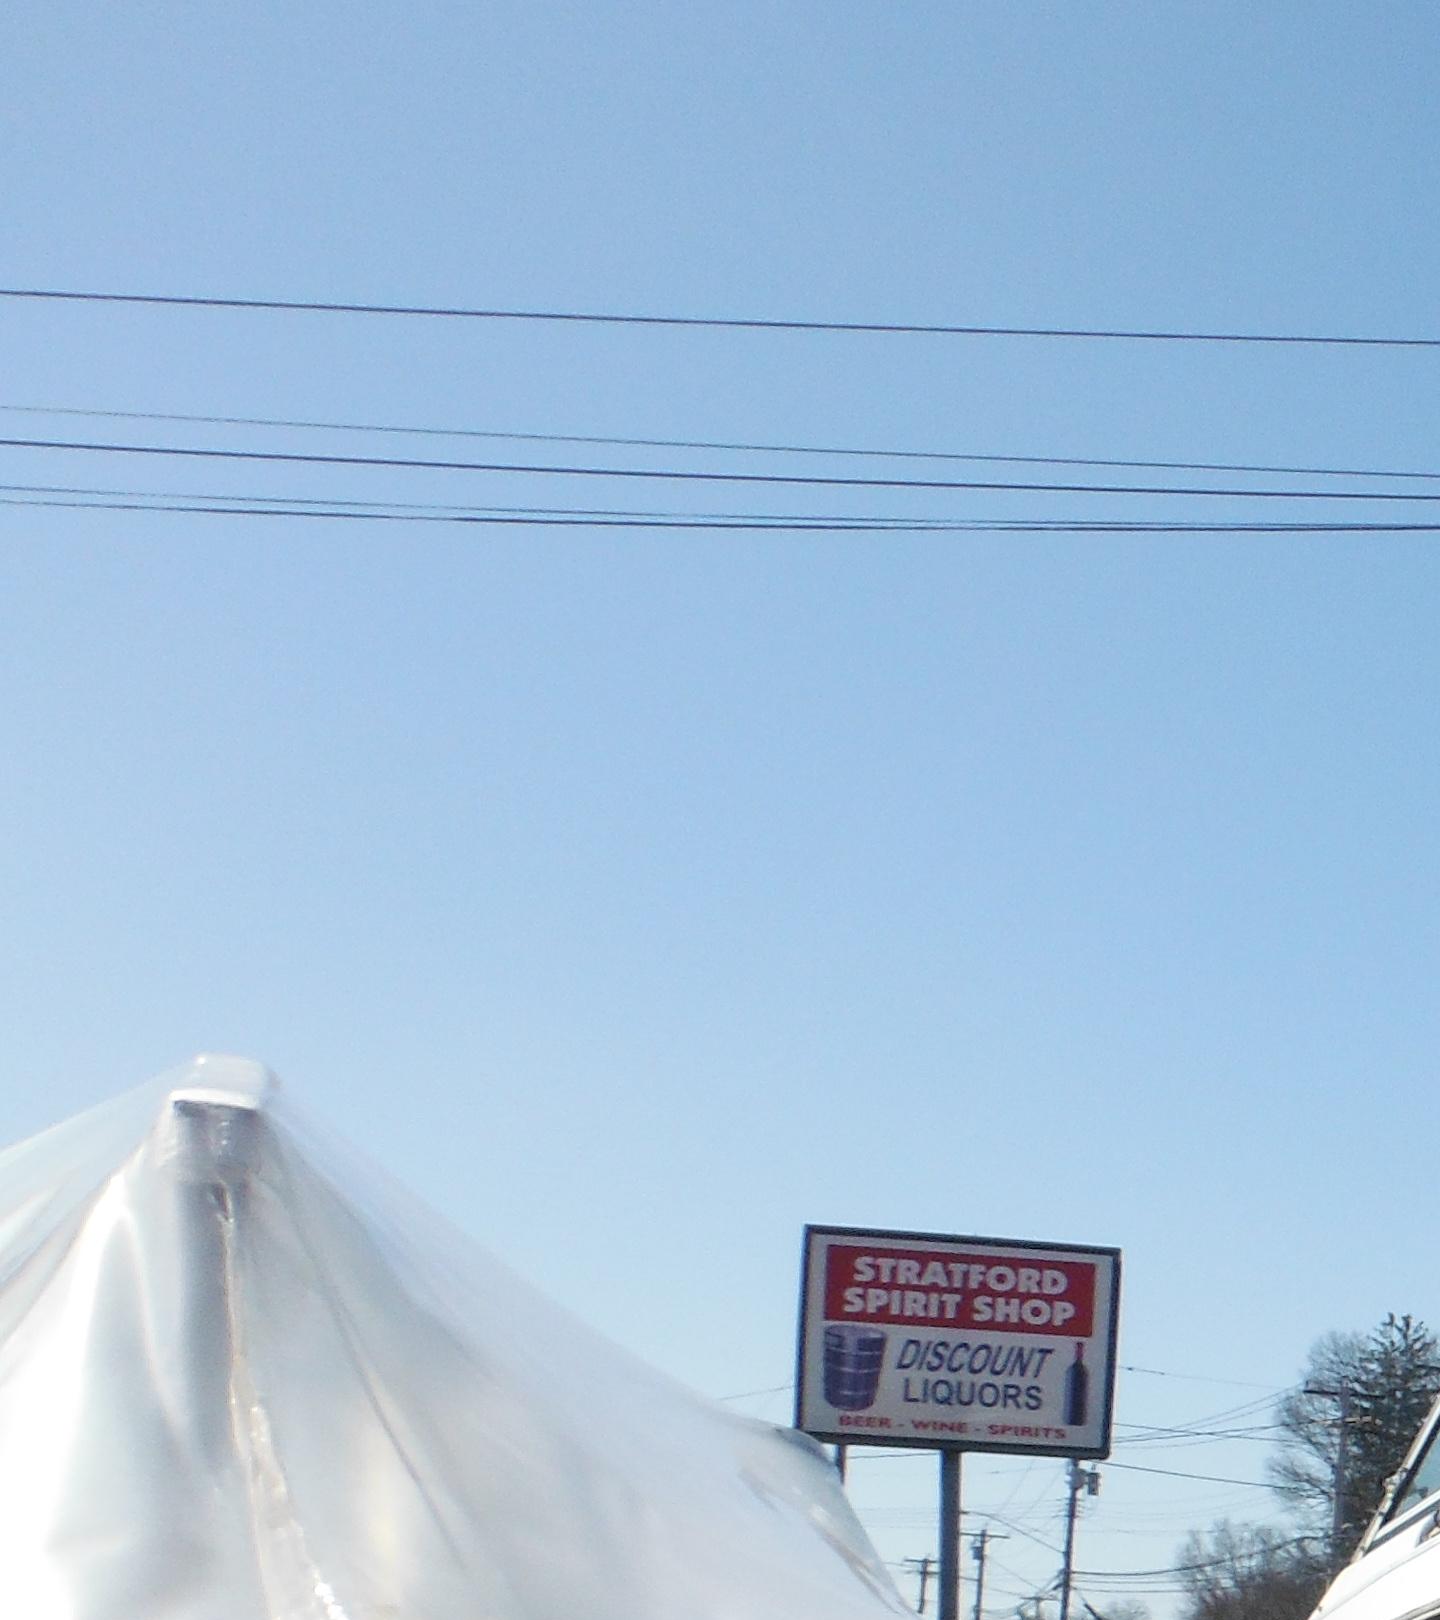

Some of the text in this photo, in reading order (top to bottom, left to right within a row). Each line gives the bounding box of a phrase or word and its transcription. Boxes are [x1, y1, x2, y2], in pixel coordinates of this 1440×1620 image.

[853, 1256, 1068, 1295] STRATFORD
[842, 1287, 1076, 1327] SPIRIT SHOP
[896, 1339, 1054, 1378] DISCOUNT
[903, 1378, 1043, 1411] LIQUORS
[839, 1415, 892, 1429] BEER
[912, 1420, 968, 1434] WINE
[987, 1424, 1067, 1439] SPIRITS
